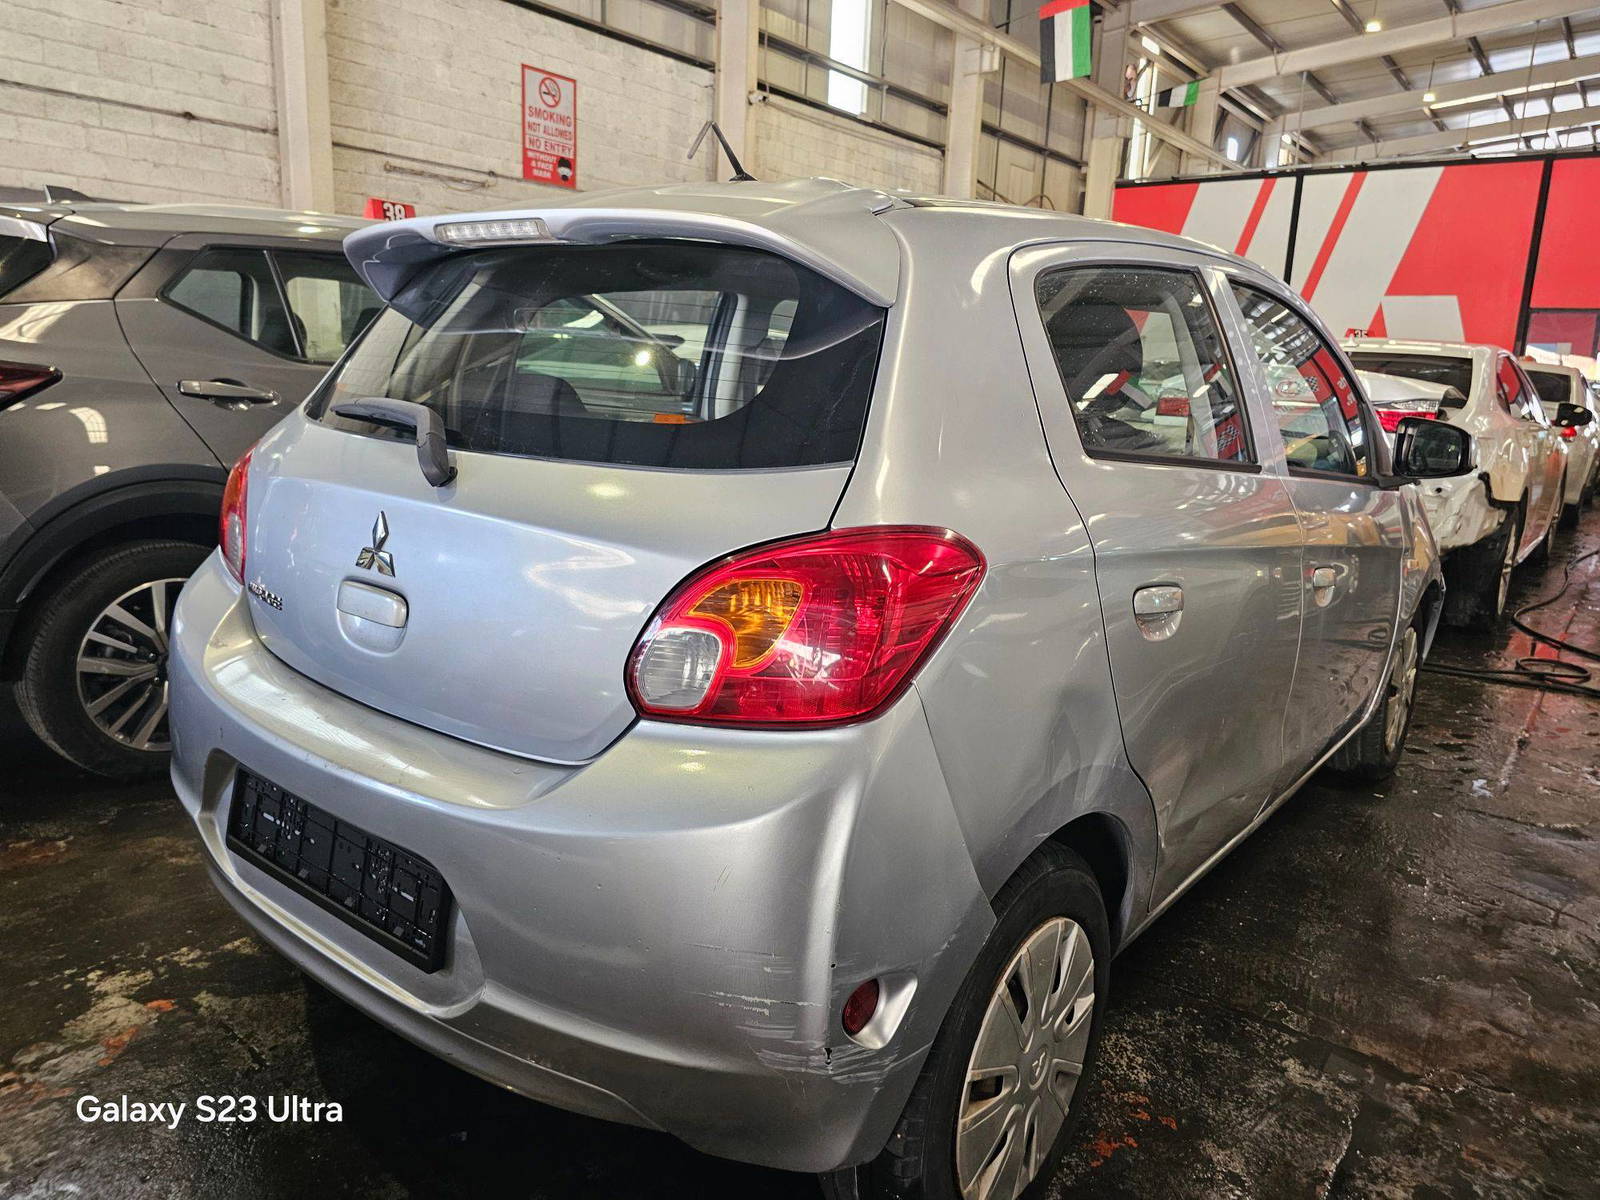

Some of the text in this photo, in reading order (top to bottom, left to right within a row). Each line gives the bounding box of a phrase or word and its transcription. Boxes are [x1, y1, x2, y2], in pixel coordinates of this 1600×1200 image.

[528, 106, 571, 127] SMOKING
[528, 121, 571, 140] NOT ALLOWED
[528, 136, 572, 156] NO ENTRY
